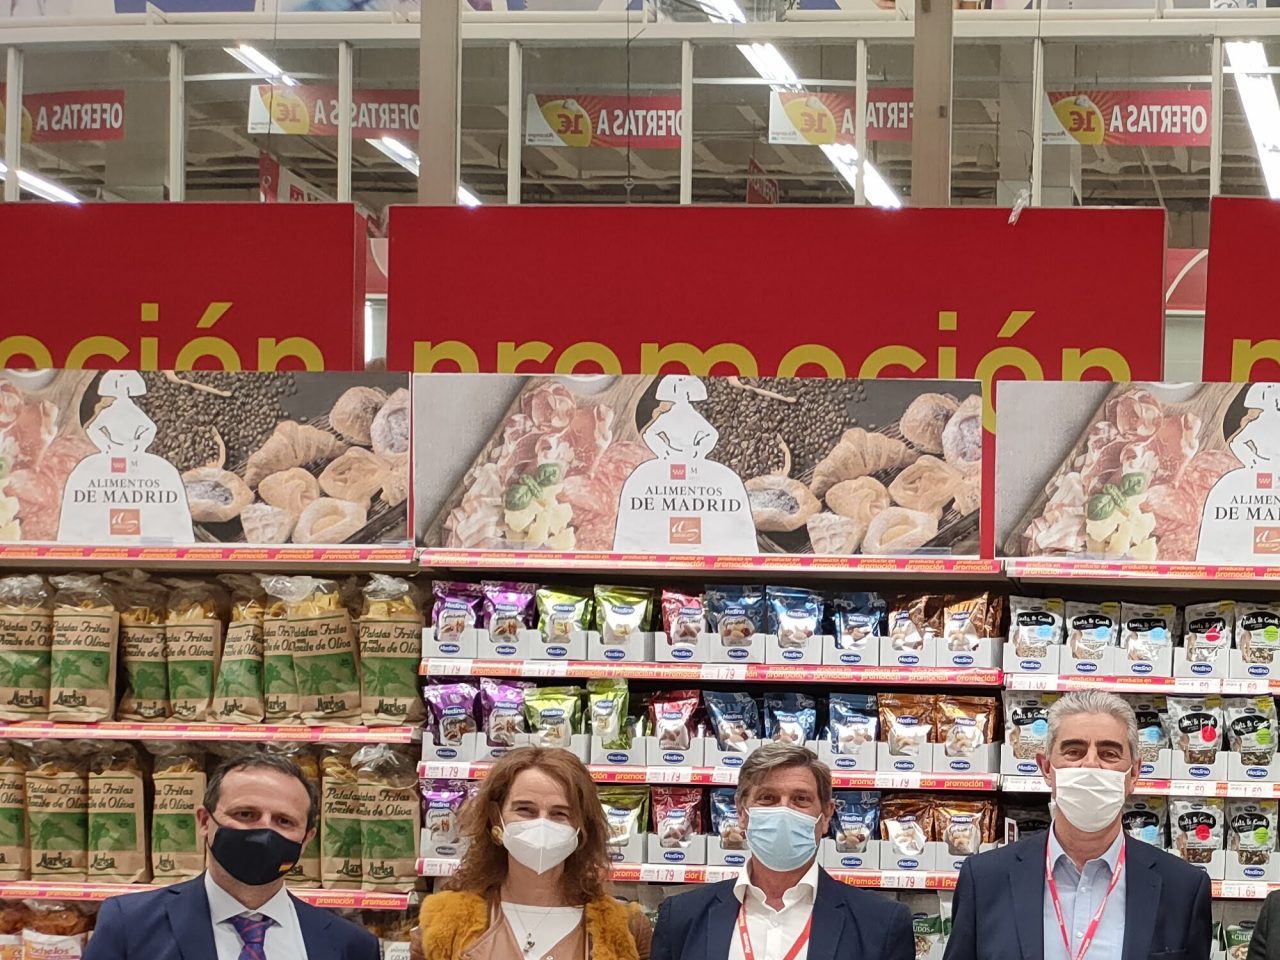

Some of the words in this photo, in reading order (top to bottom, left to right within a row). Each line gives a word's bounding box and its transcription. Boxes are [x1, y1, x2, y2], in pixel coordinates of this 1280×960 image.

[88, 478, 160, 488] ALIMENTOS
[73, 489, 97, 503] DE
[103, 489, 178, 504] MADRID
[645, 485, 722, 496] ALIMENTOS
[630, 497, 655, 511] DE
[661, 498, 741, 512] MADRID
[1214, 507, 1239, 521] DE
[944, 780, 984, 788] promoción
